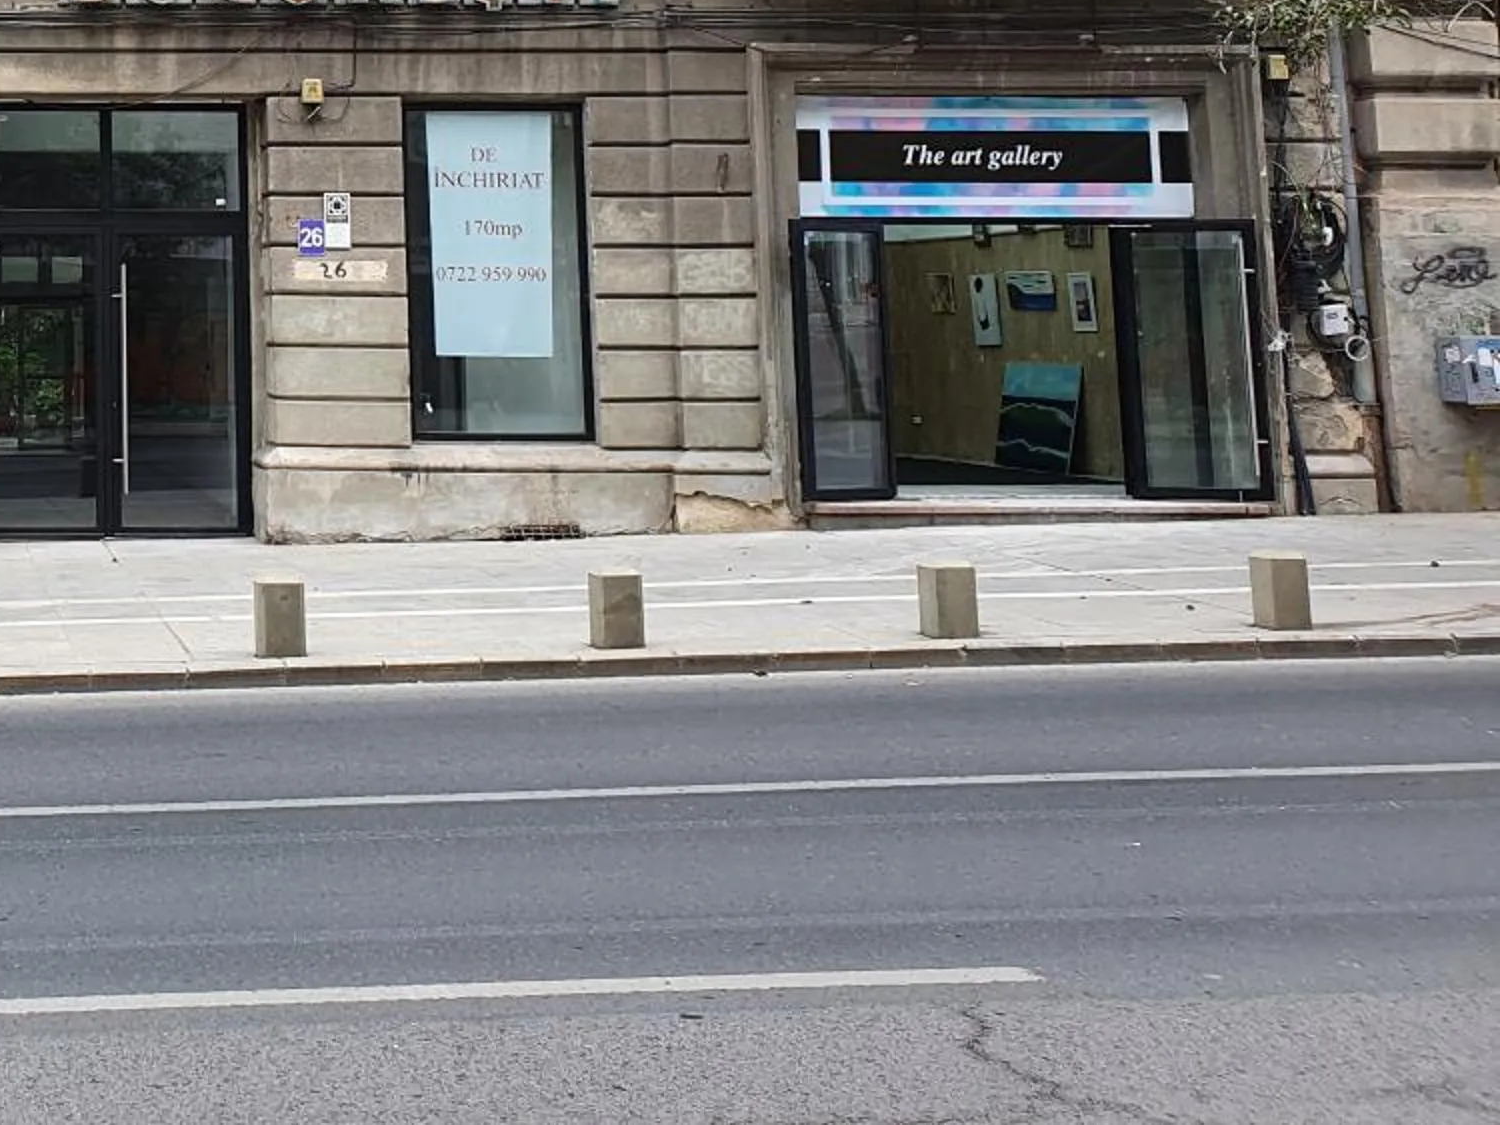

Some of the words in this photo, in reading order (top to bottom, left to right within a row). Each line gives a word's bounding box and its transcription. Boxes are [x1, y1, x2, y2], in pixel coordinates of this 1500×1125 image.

[470, 146, 497, 163] DE
[903, 144, 944, 166] The
[951, 145, 983, 166] art
[988, 144, 1063, 169] gallery
[300, 227, 323, 248] 26
[465, 219, 523, 241] 170mp
[320, 261, 347, 279] 26
[436, 266, 476, 282] 0722
[482, 266, 513, 282] 959
[517, 266, 547, 282] 990
